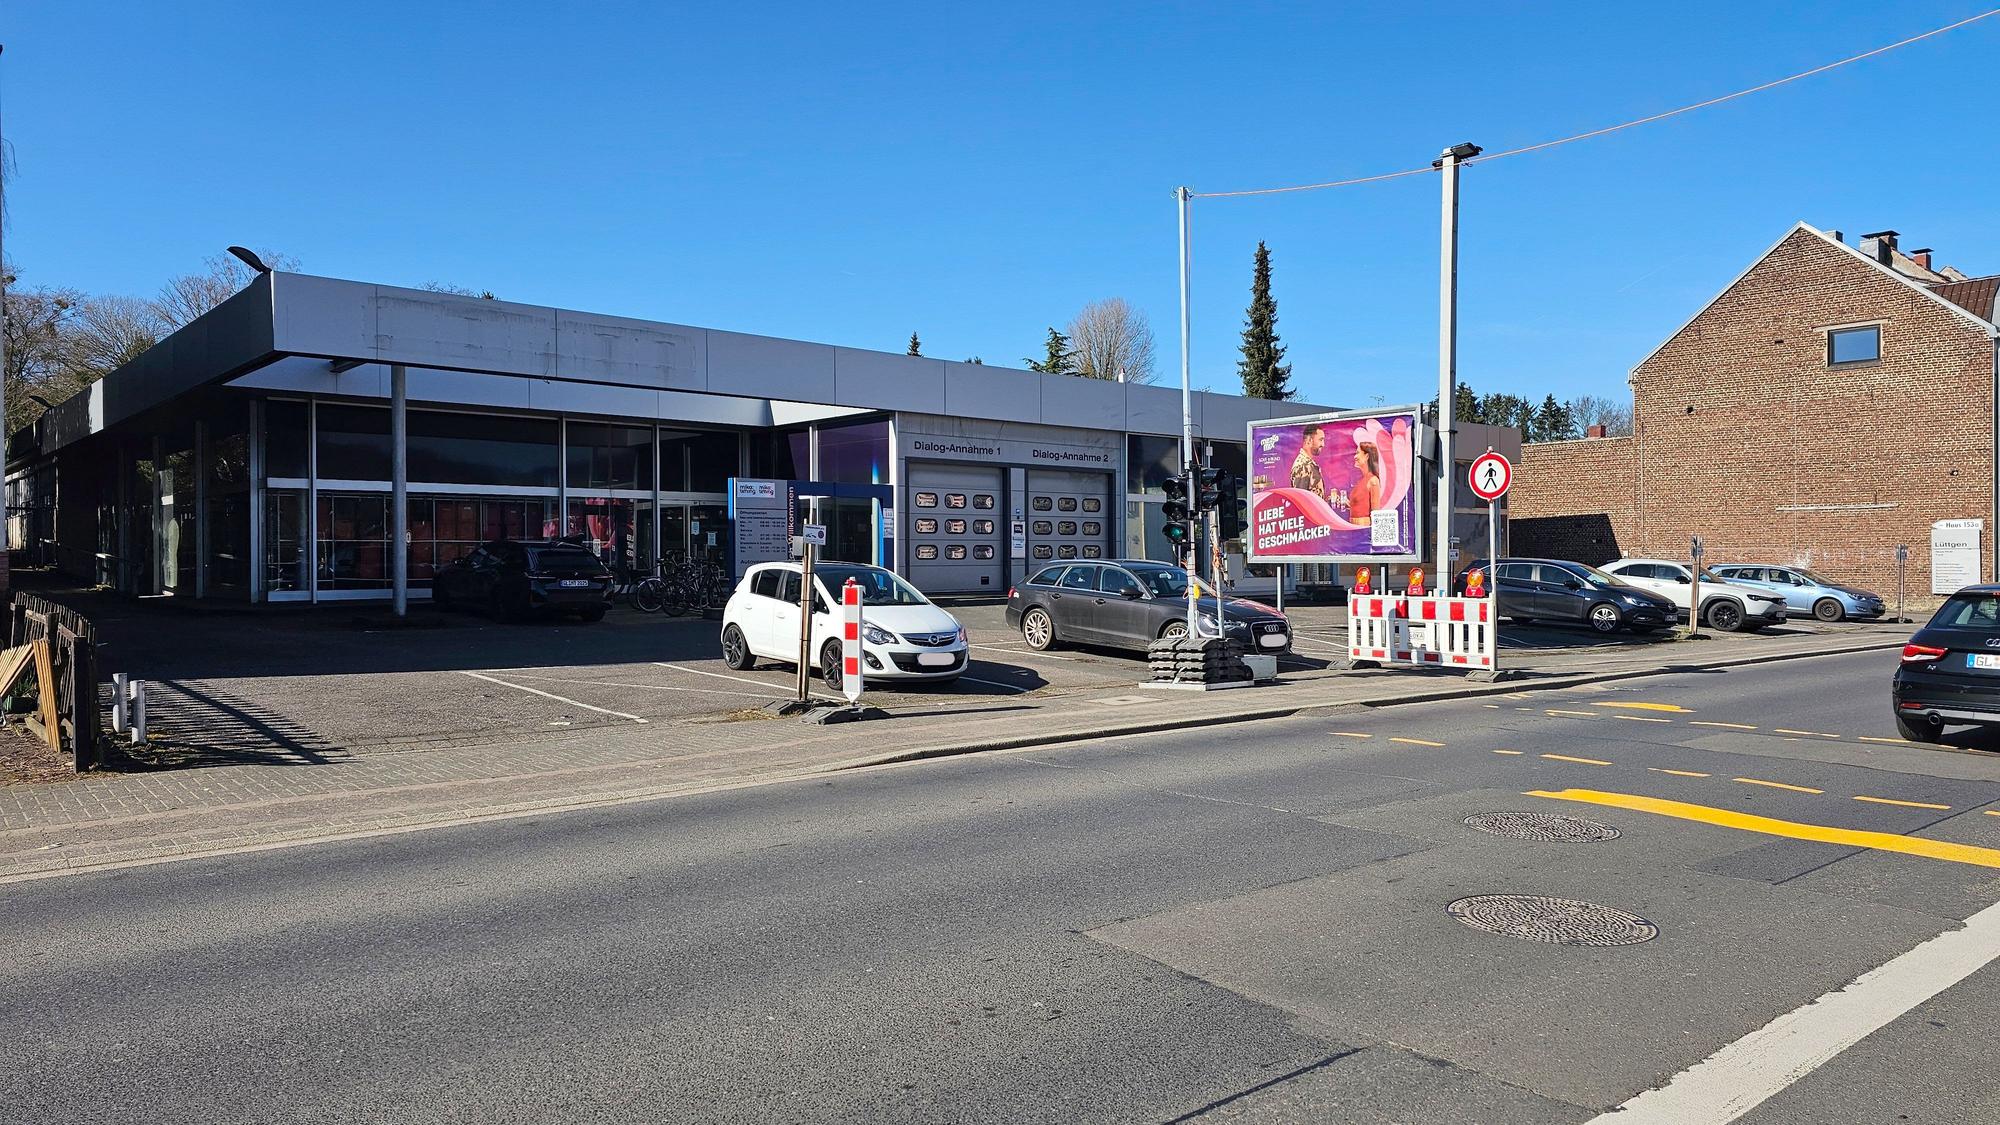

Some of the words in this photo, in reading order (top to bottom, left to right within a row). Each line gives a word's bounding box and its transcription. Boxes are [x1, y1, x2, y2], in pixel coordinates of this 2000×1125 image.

[914, 441, 994, 455] Dialog-Annahme
[997, 447, 1001, 455] 1
[1032, 449, 1101, 462] Dialog-Annahme
[1258, 506, 1285, 522] LIEBE
[1258, 521, 1277, 535] HAT
[1278, 516, 1305, 531] VIELE
[1258, 525, 1331, 549] GESCHMÄCKER
[1976, 656, 1992, 667] GL
